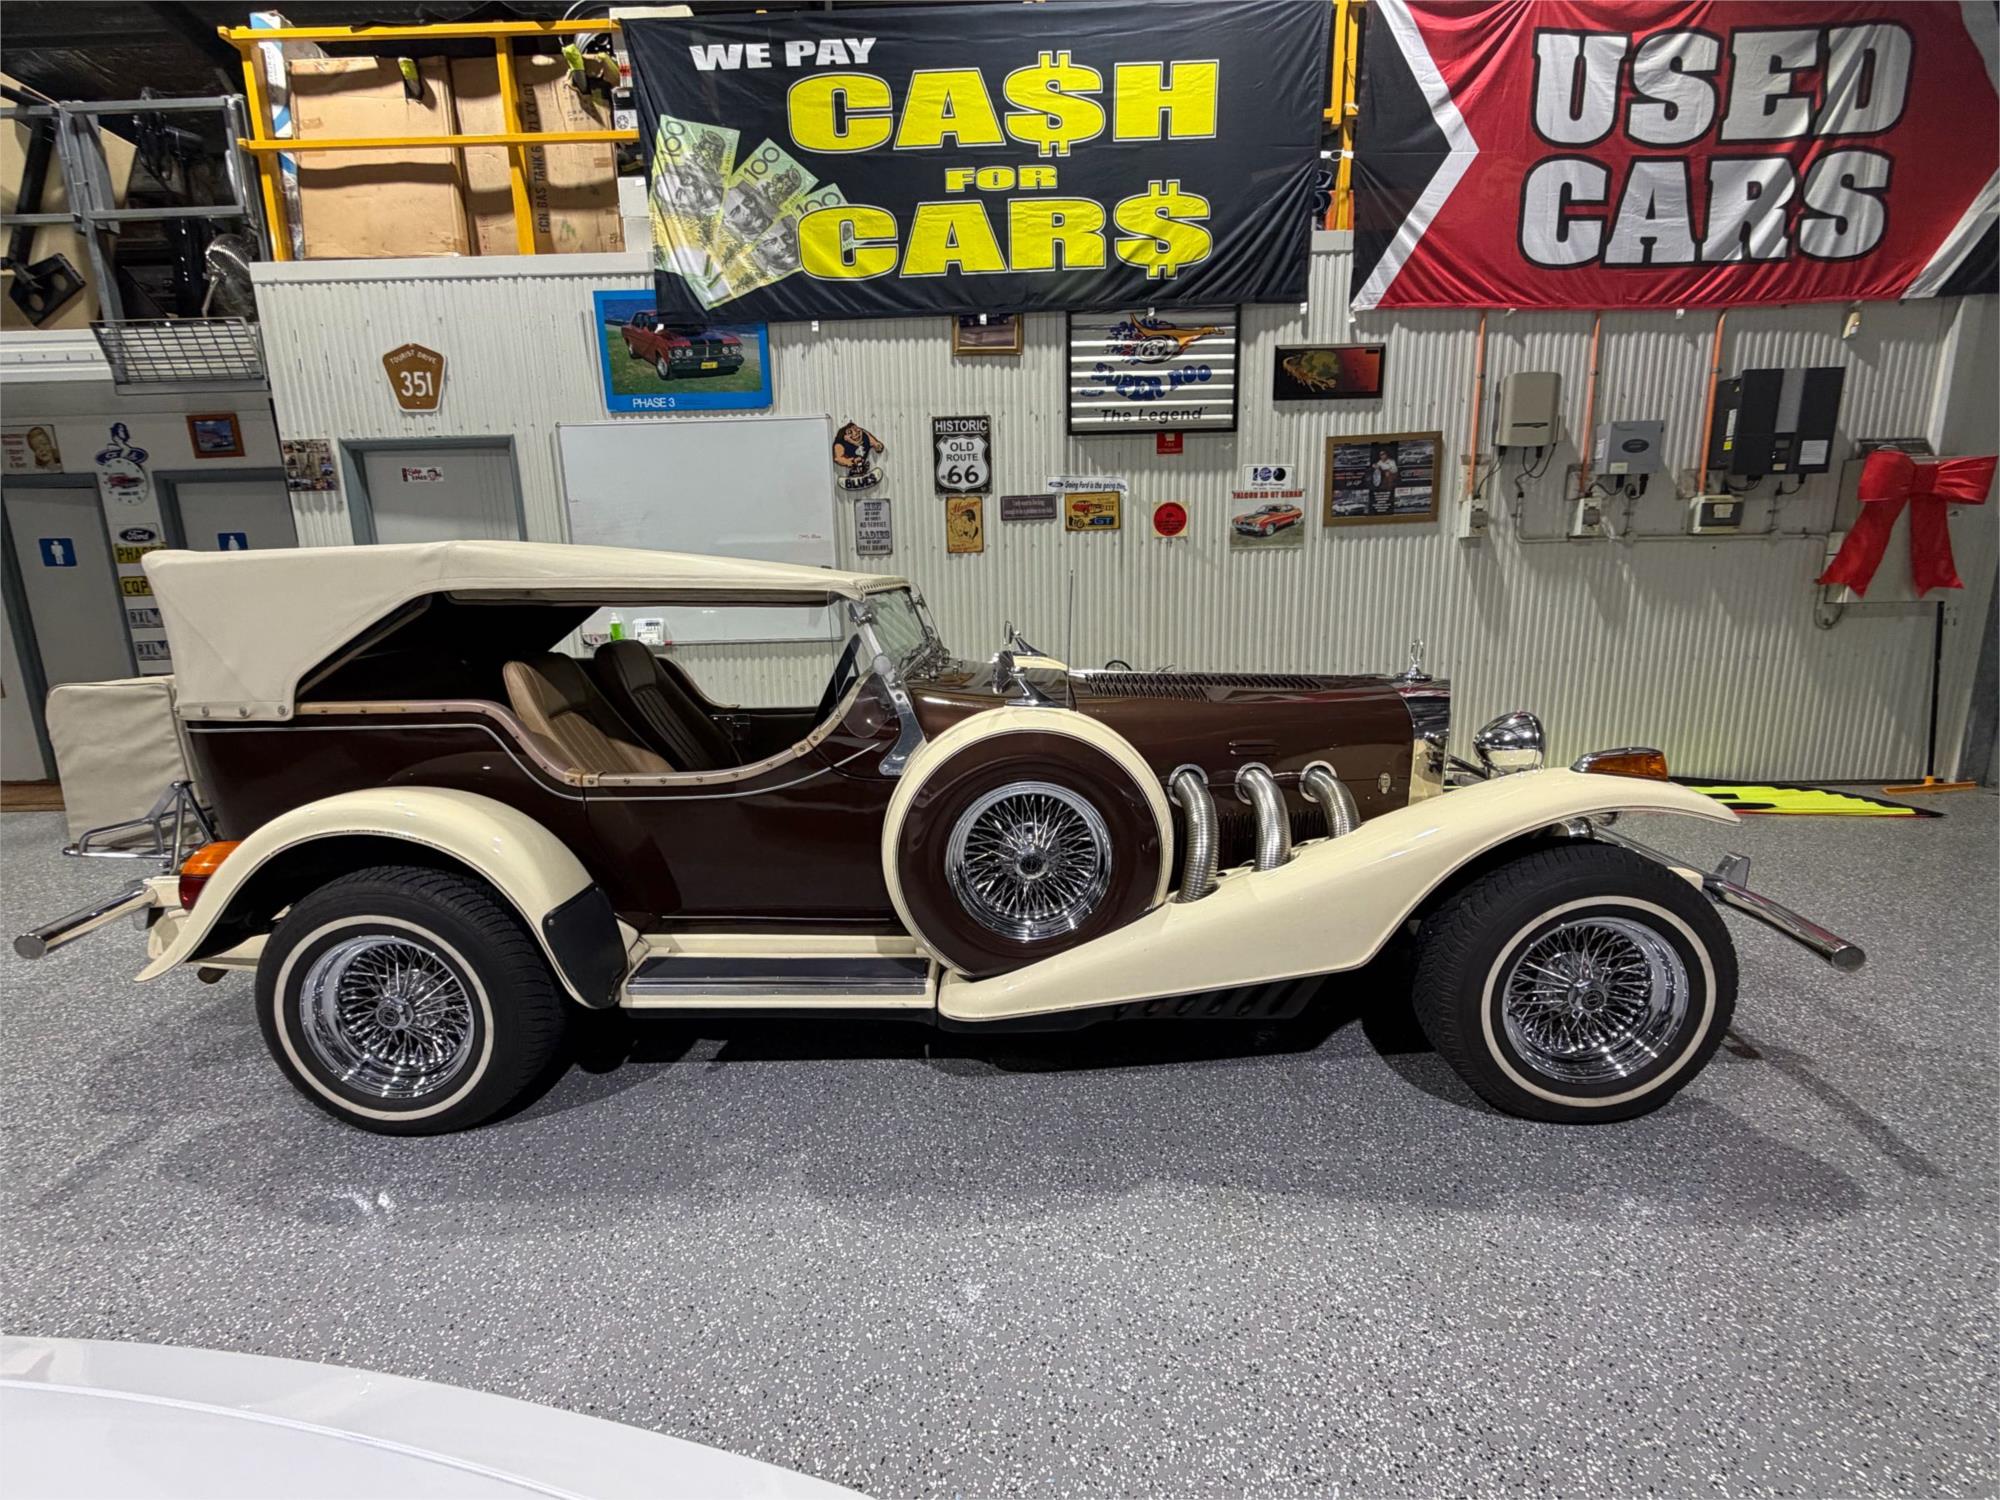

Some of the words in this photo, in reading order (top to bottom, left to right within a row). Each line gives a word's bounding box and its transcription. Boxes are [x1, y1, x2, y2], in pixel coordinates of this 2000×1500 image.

[690, 44, 772, 70] WE
[786, 38, 877, 66] PAY
[1533, 21, 1912, 147] USED
[787, 51, 1220, 157] CA$H
[660, 120, 686, 157] 100
[532, 157, 546, 182] TANK
[744, 147, 780, 181] 100
[945, 164, 1058, 192] FOR
[1519, 149, 1892, 268] CARS
[797, 180, 1212, 280] CAR$
[390, 349, 415, 364] TOURIST
[417, 352, 436, 364] DRIVE
[400, 371, 434, 397] 351
[633, 398, 668, 408] PHASE
[668, 397, 675, 407] 3
[935, 420, 988, 432] HISTORIC
[946, 453, 979, 462] ROUTE
[950, 441, 975, 452] OLD
[844, 473, 877, 489] BLUES
[947, 465, 979, 484] 66
[1064, 480, 1078, 490] Going
[1079, 480, 1090, 489] Ford
[1094, 480, 1102, 489] the
[1232, 491, 1258, 499] FALCON
[126, 530, 149, 541] Ford
